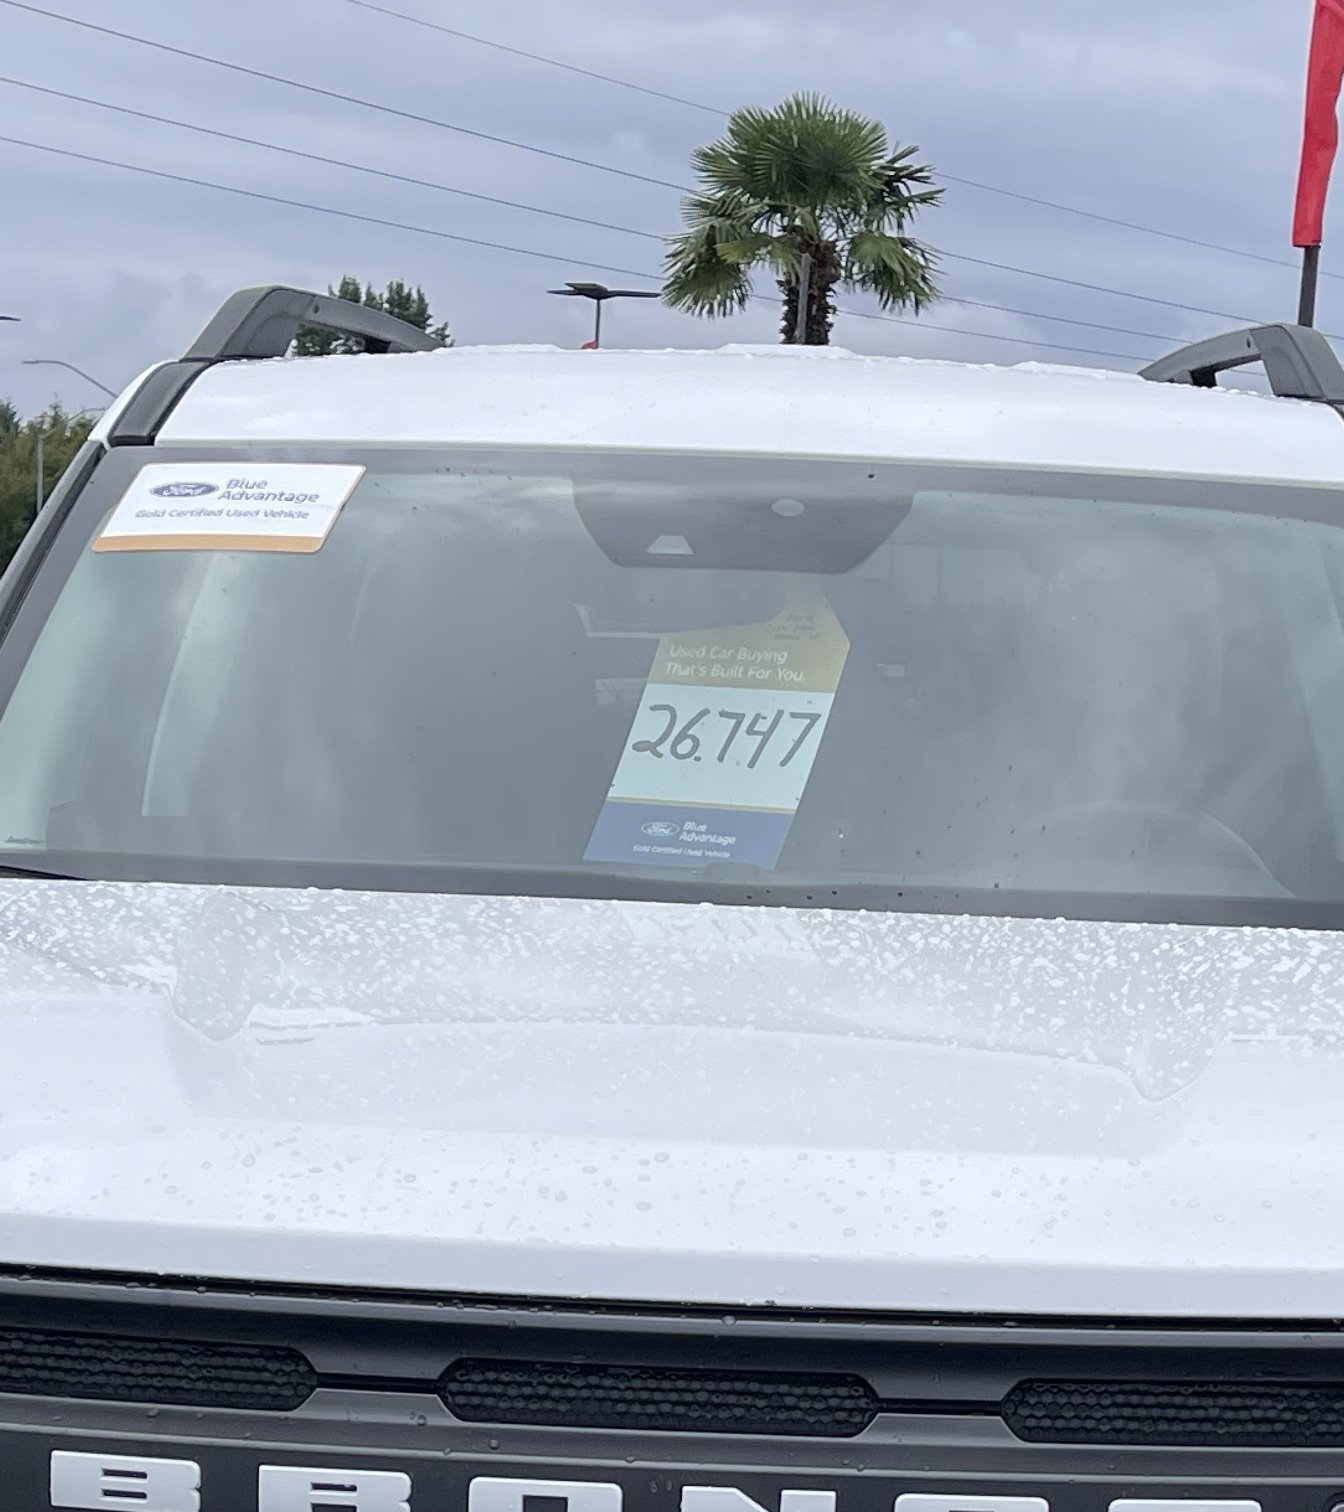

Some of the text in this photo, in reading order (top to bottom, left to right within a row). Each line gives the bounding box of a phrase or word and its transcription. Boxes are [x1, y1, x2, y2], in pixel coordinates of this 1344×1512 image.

[226, 478, 268, 490] Blue
[217, 490, 320, 503] Advantage
[135, 508, 310, 520] Gold Certified Used Vehicle
[670, 644, 788, 665] Used Car Buying
[664, 662, 708, 677] That's
[710, 663, 744, 678] Built
[747, 665, 773, 680] For
[683, 821, 708, 832] Blue
[679, 831, 736, 846] Advantage
